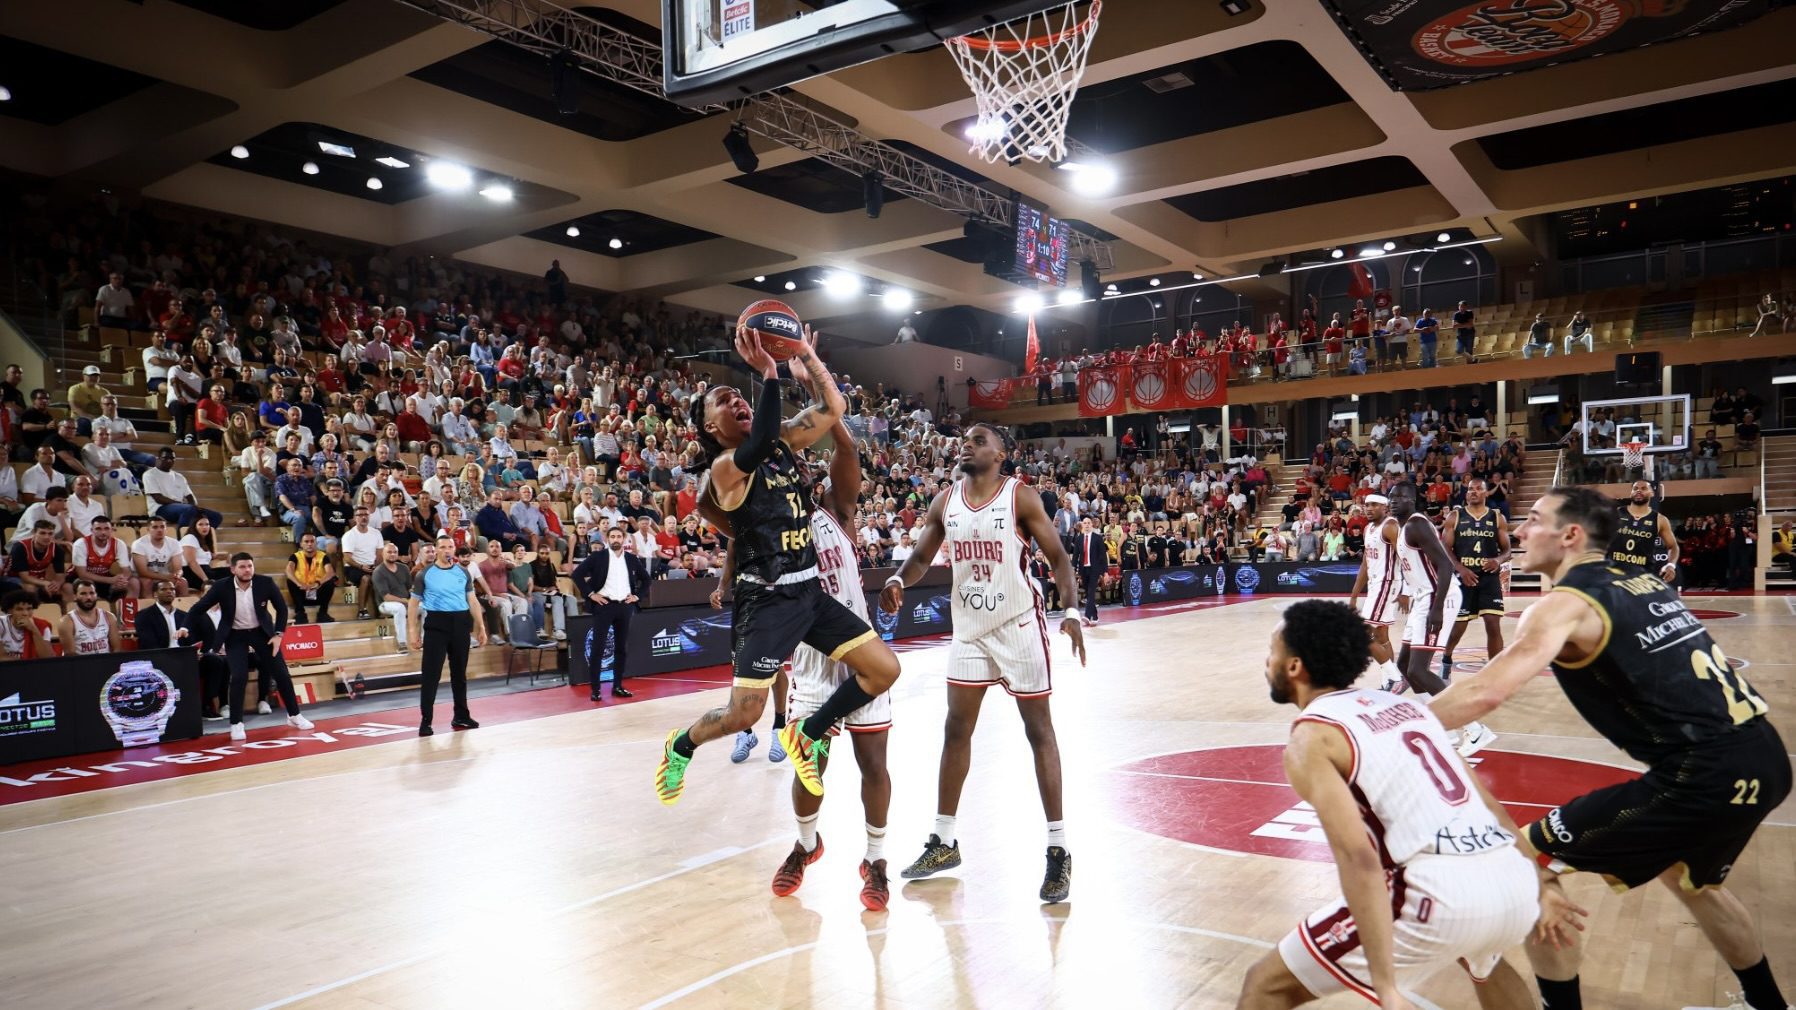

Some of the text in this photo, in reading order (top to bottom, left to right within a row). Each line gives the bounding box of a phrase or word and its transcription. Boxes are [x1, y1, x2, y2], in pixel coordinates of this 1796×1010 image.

[724, 16, 751, 37] ÉLITE
[766, 317, 798, 332] Betclic
[1459, 529, 1494, 538] MONACO
[954, 540, 1003, 563] BOURG
[1473, 541, 1481, 553] 4
[1625, 539, 1635, 551] 0
[1612, 552, 1647, 565] FEDCOM
[972, 564, 991, 582] 34
[960, 593, 996, 611] YOU
[652, 637, 681, 649] LOTUS
[0, 704, 56, 724] OTUS
[1356, 702, 1427, 734] McGHEE
[1402, 731, 1470, 807] 0
[1729, 779, 1760, 805] 22
[1416, 897, 1432, 924] 0
